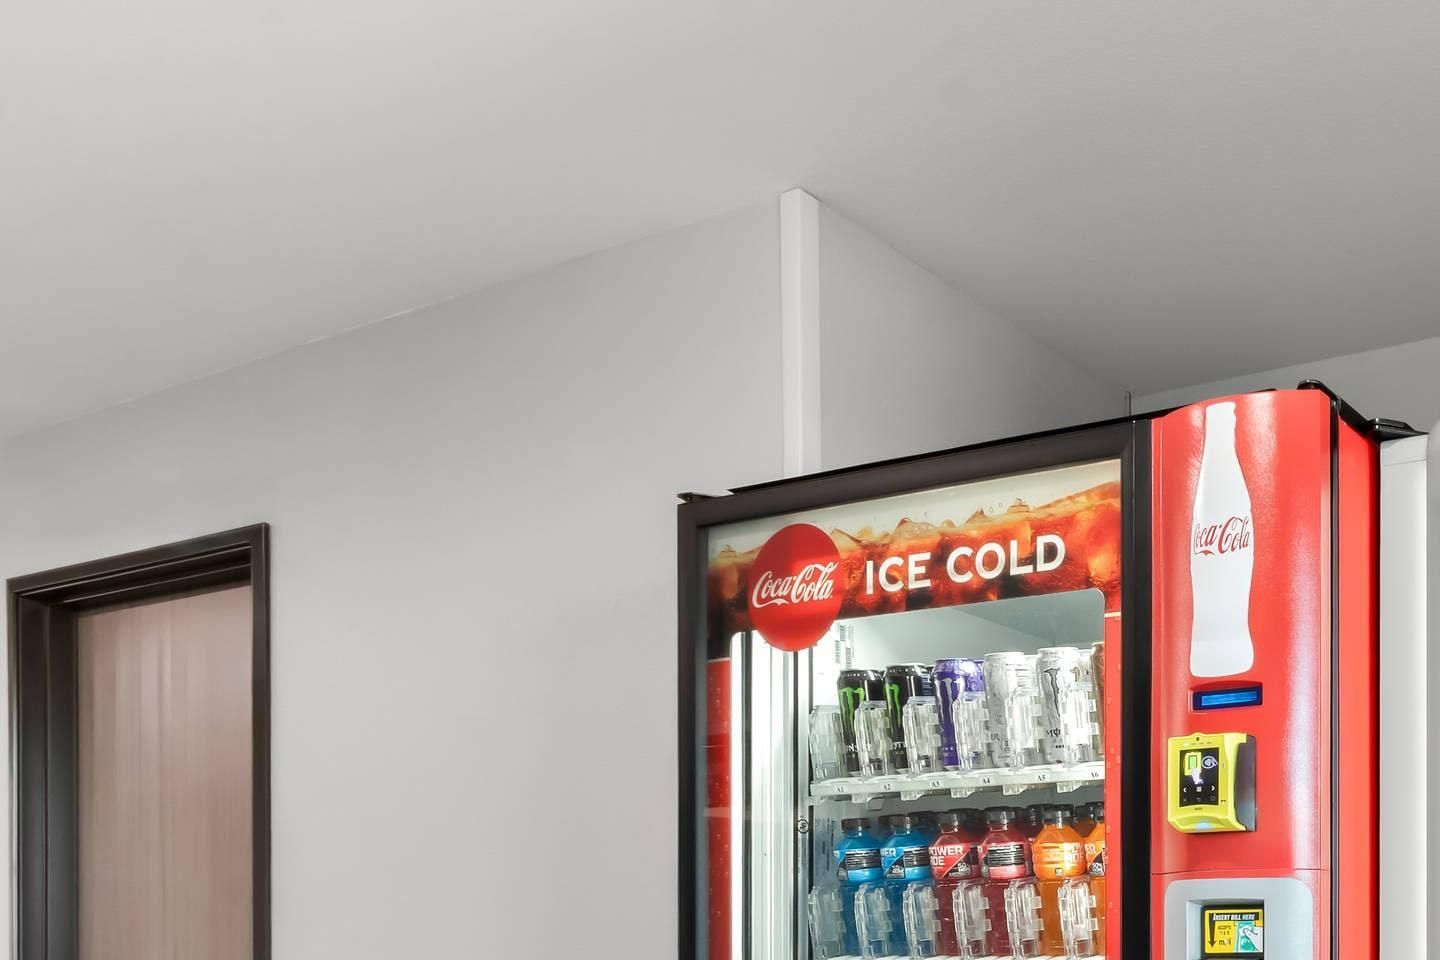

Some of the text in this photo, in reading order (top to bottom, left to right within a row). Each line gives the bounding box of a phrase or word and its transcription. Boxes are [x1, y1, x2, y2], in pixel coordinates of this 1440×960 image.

[752, 561, 839, 608] Coca-Cola
[865, 534, 1066, 595] ICE COLD
